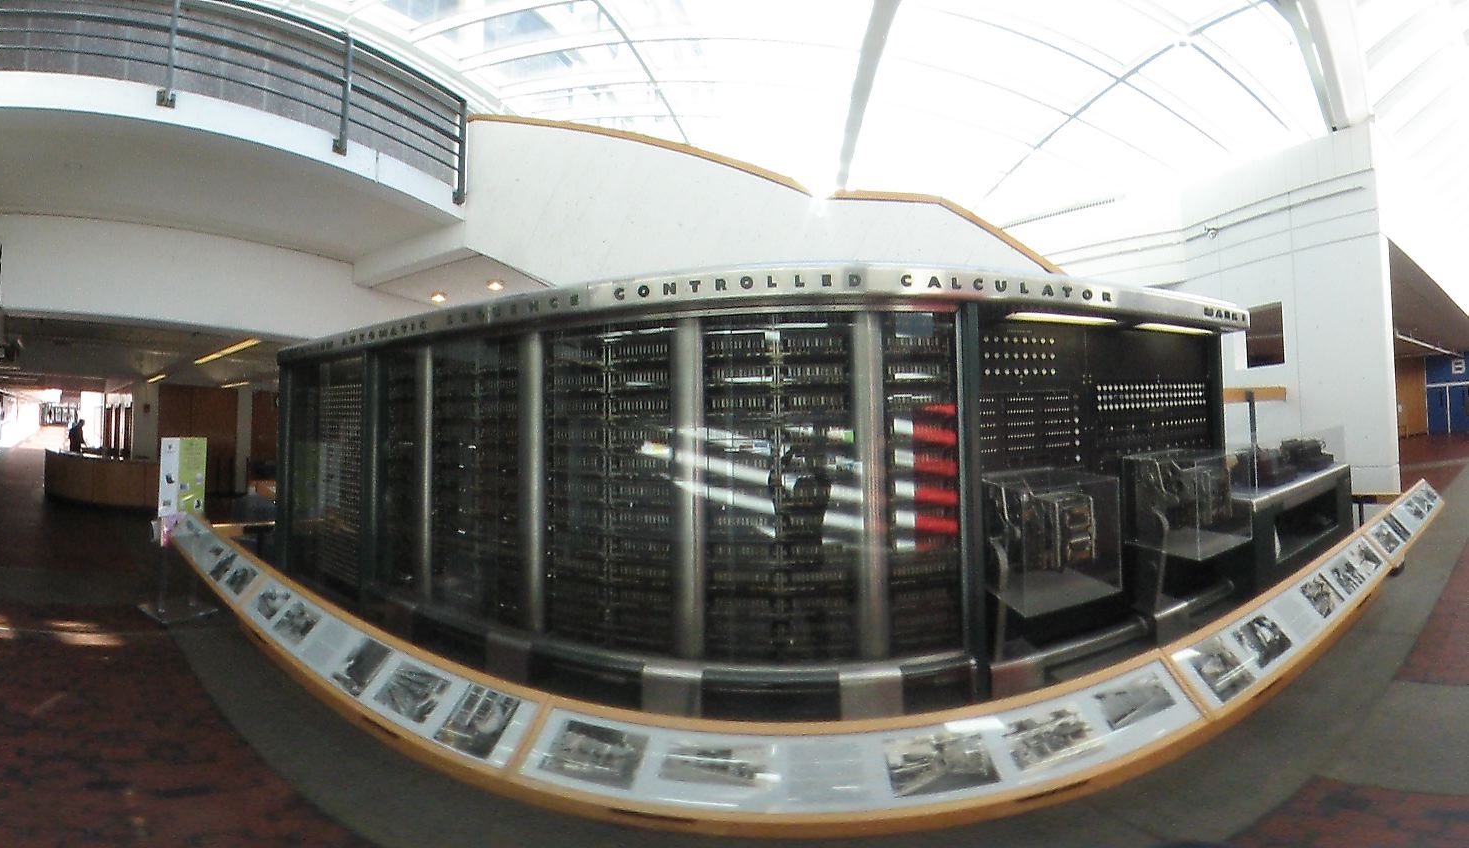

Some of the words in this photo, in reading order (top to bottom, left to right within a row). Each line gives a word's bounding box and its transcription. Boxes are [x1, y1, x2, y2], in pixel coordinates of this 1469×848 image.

[613, 273, 862, 300] CONTROLLED
[900, 274, 1112, 302] CALCULATOR
[1203, 306, 1238, 321] MARK
